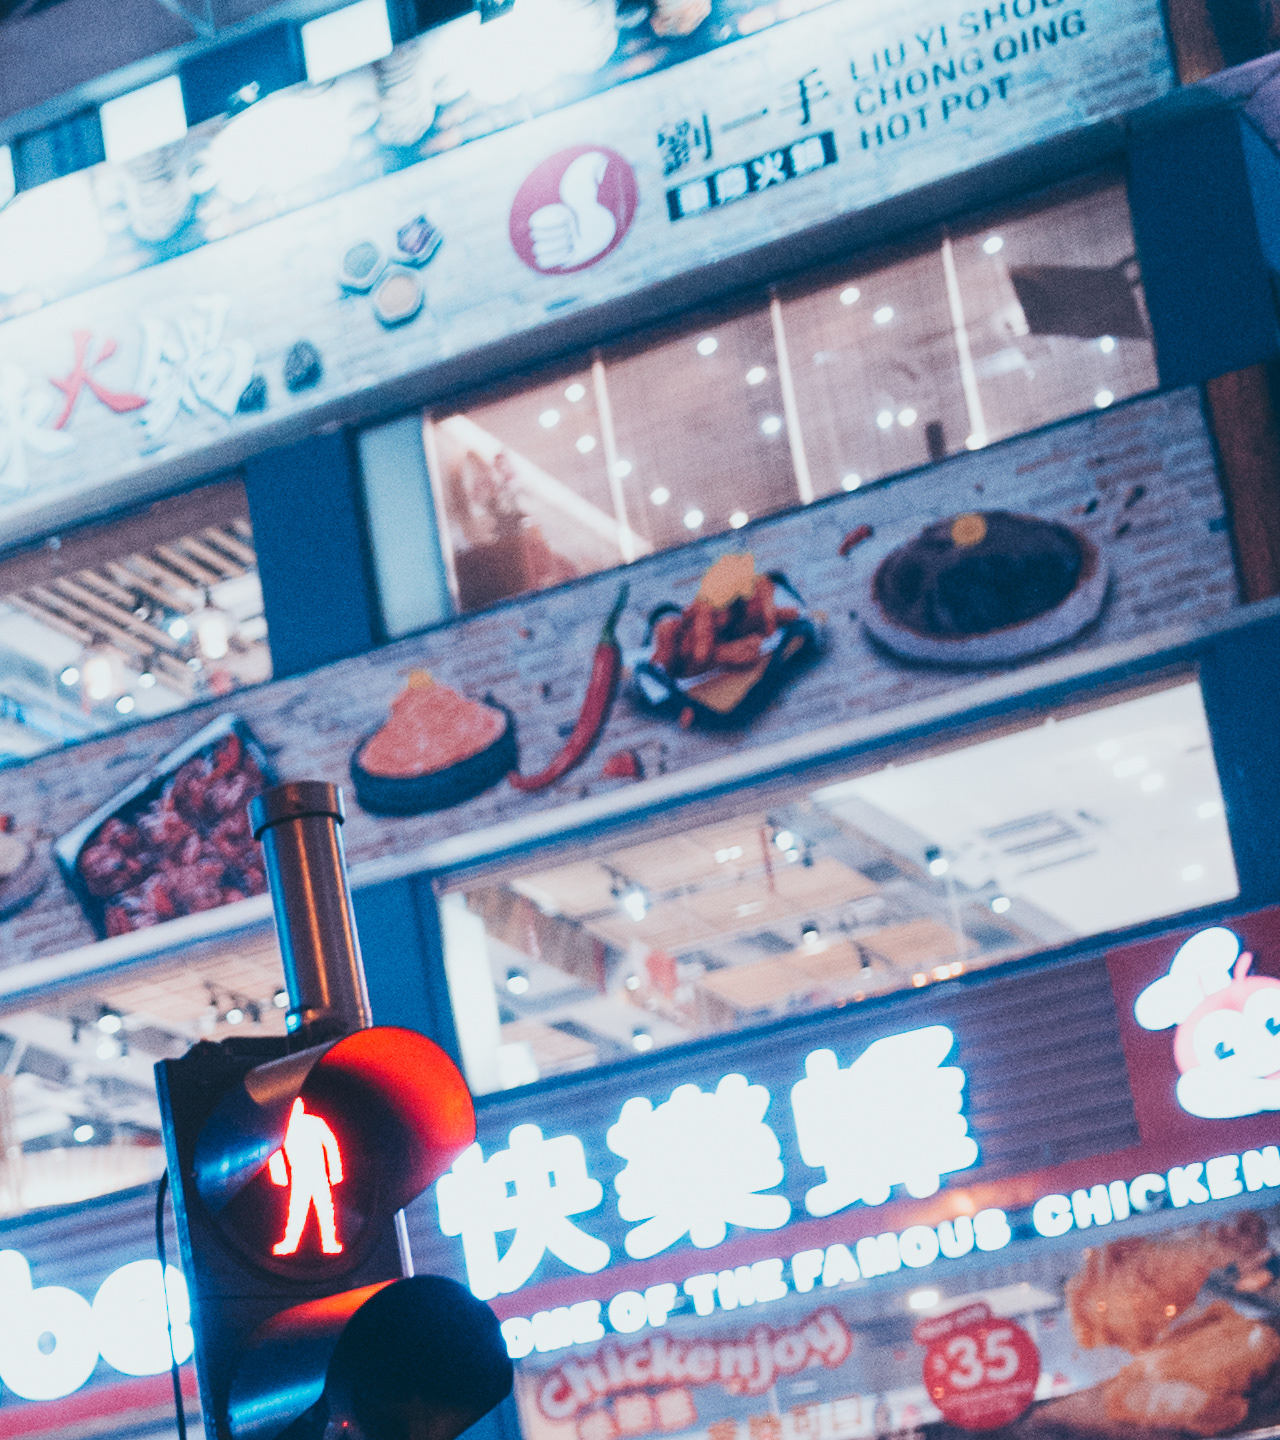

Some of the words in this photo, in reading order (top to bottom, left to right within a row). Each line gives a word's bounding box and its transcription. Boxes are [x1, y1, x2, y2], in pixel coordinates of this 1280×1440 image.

[848, 41, 907, 81] LIU
[915, 24, 950, 59] YI
[853, 46, 985, 117] CHONG
[992, 8, 1087, 63] QING
[860, 102, 929, 151] HOT
[940, 71, 1014, 122] POT
[501, 1300, 605, 1359] OME
[608, 1283, 678, 1337] OF
[683, 1258, 788, 1317] THE
[792, 1208, 1011, 1293] FAMOUS
[541, 1307, 852, 1419] Chickenjoy
